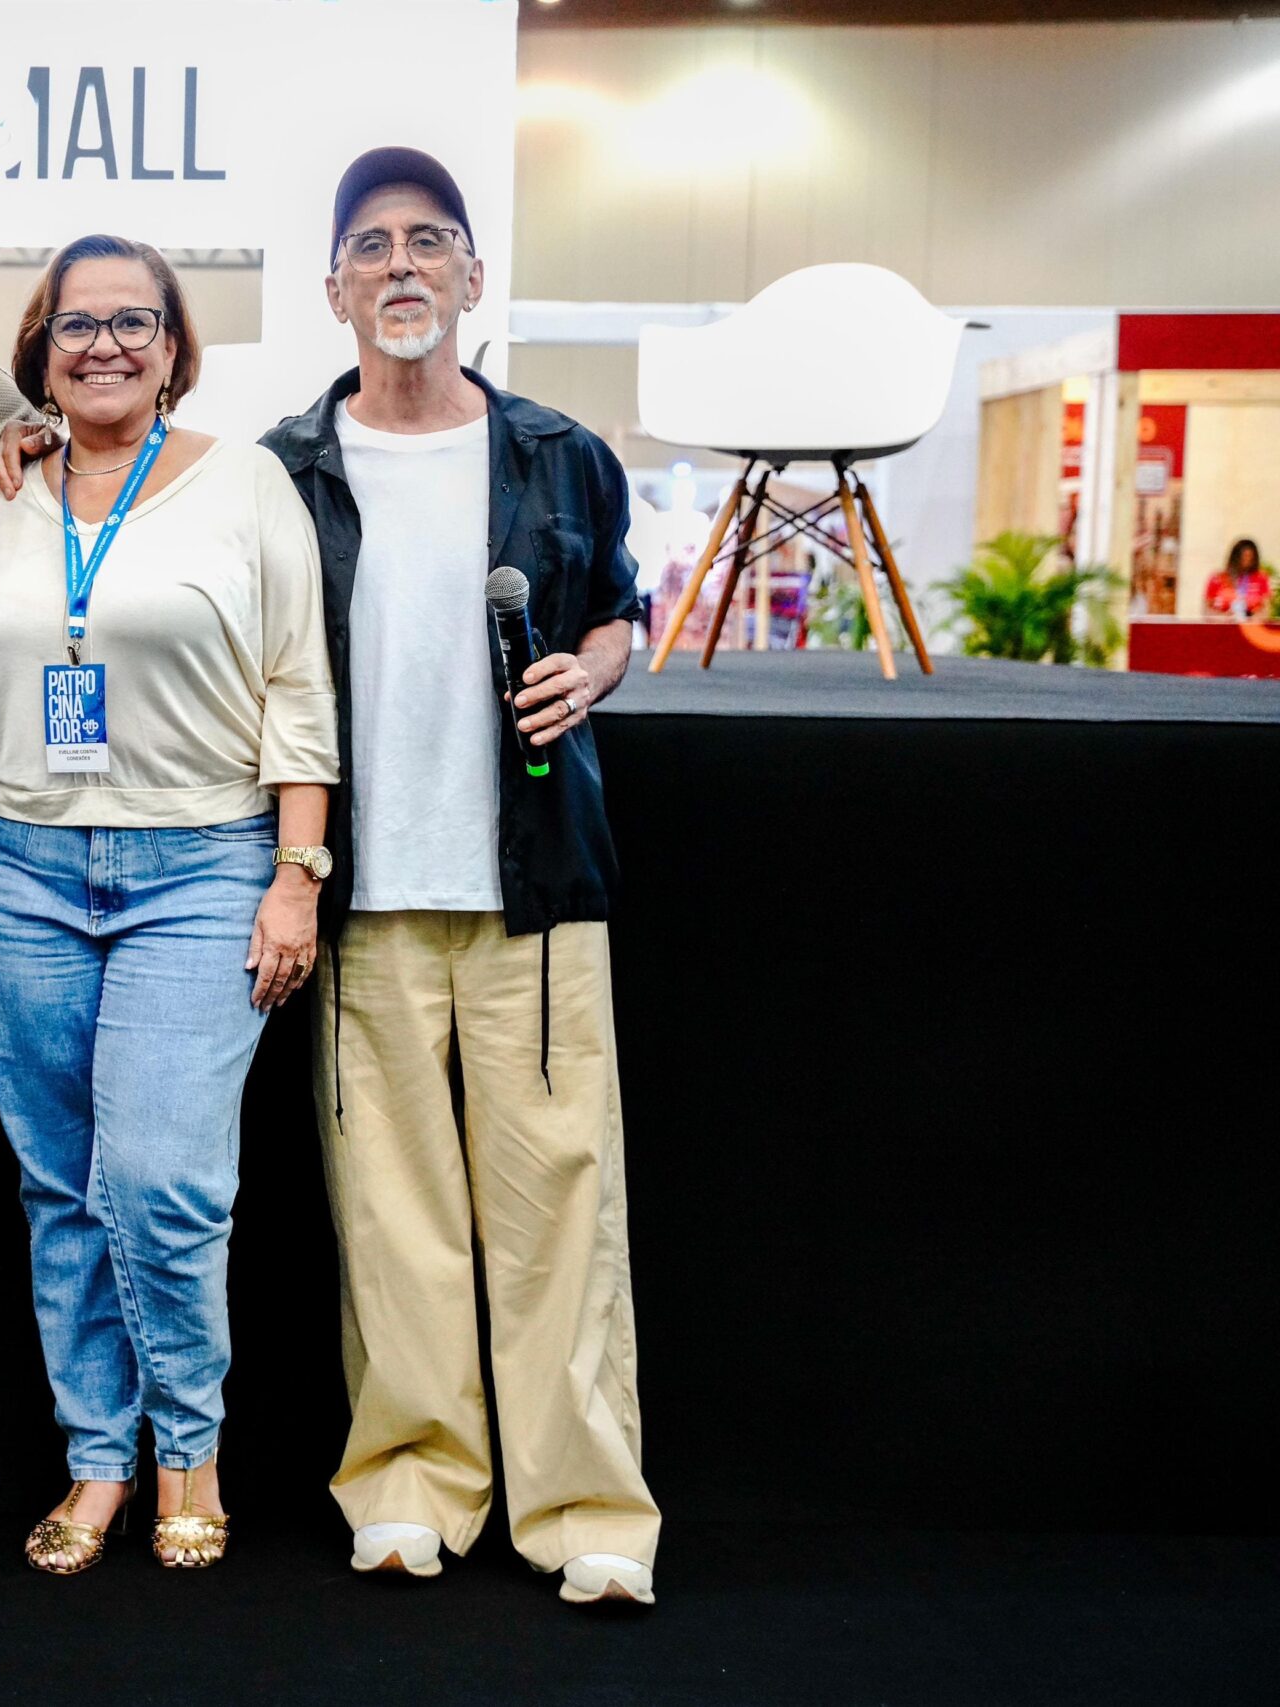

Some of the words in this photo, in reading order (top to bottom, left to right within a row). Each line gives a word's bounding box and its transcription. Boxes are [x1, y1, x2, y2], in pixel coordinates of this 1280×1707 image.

[138, 449, 154, 475] AUTORAL
[48, 670, 95, 695] PATRO
[48, 694, 85, 719] CINA
[49, 718, 82, 744] DOR
